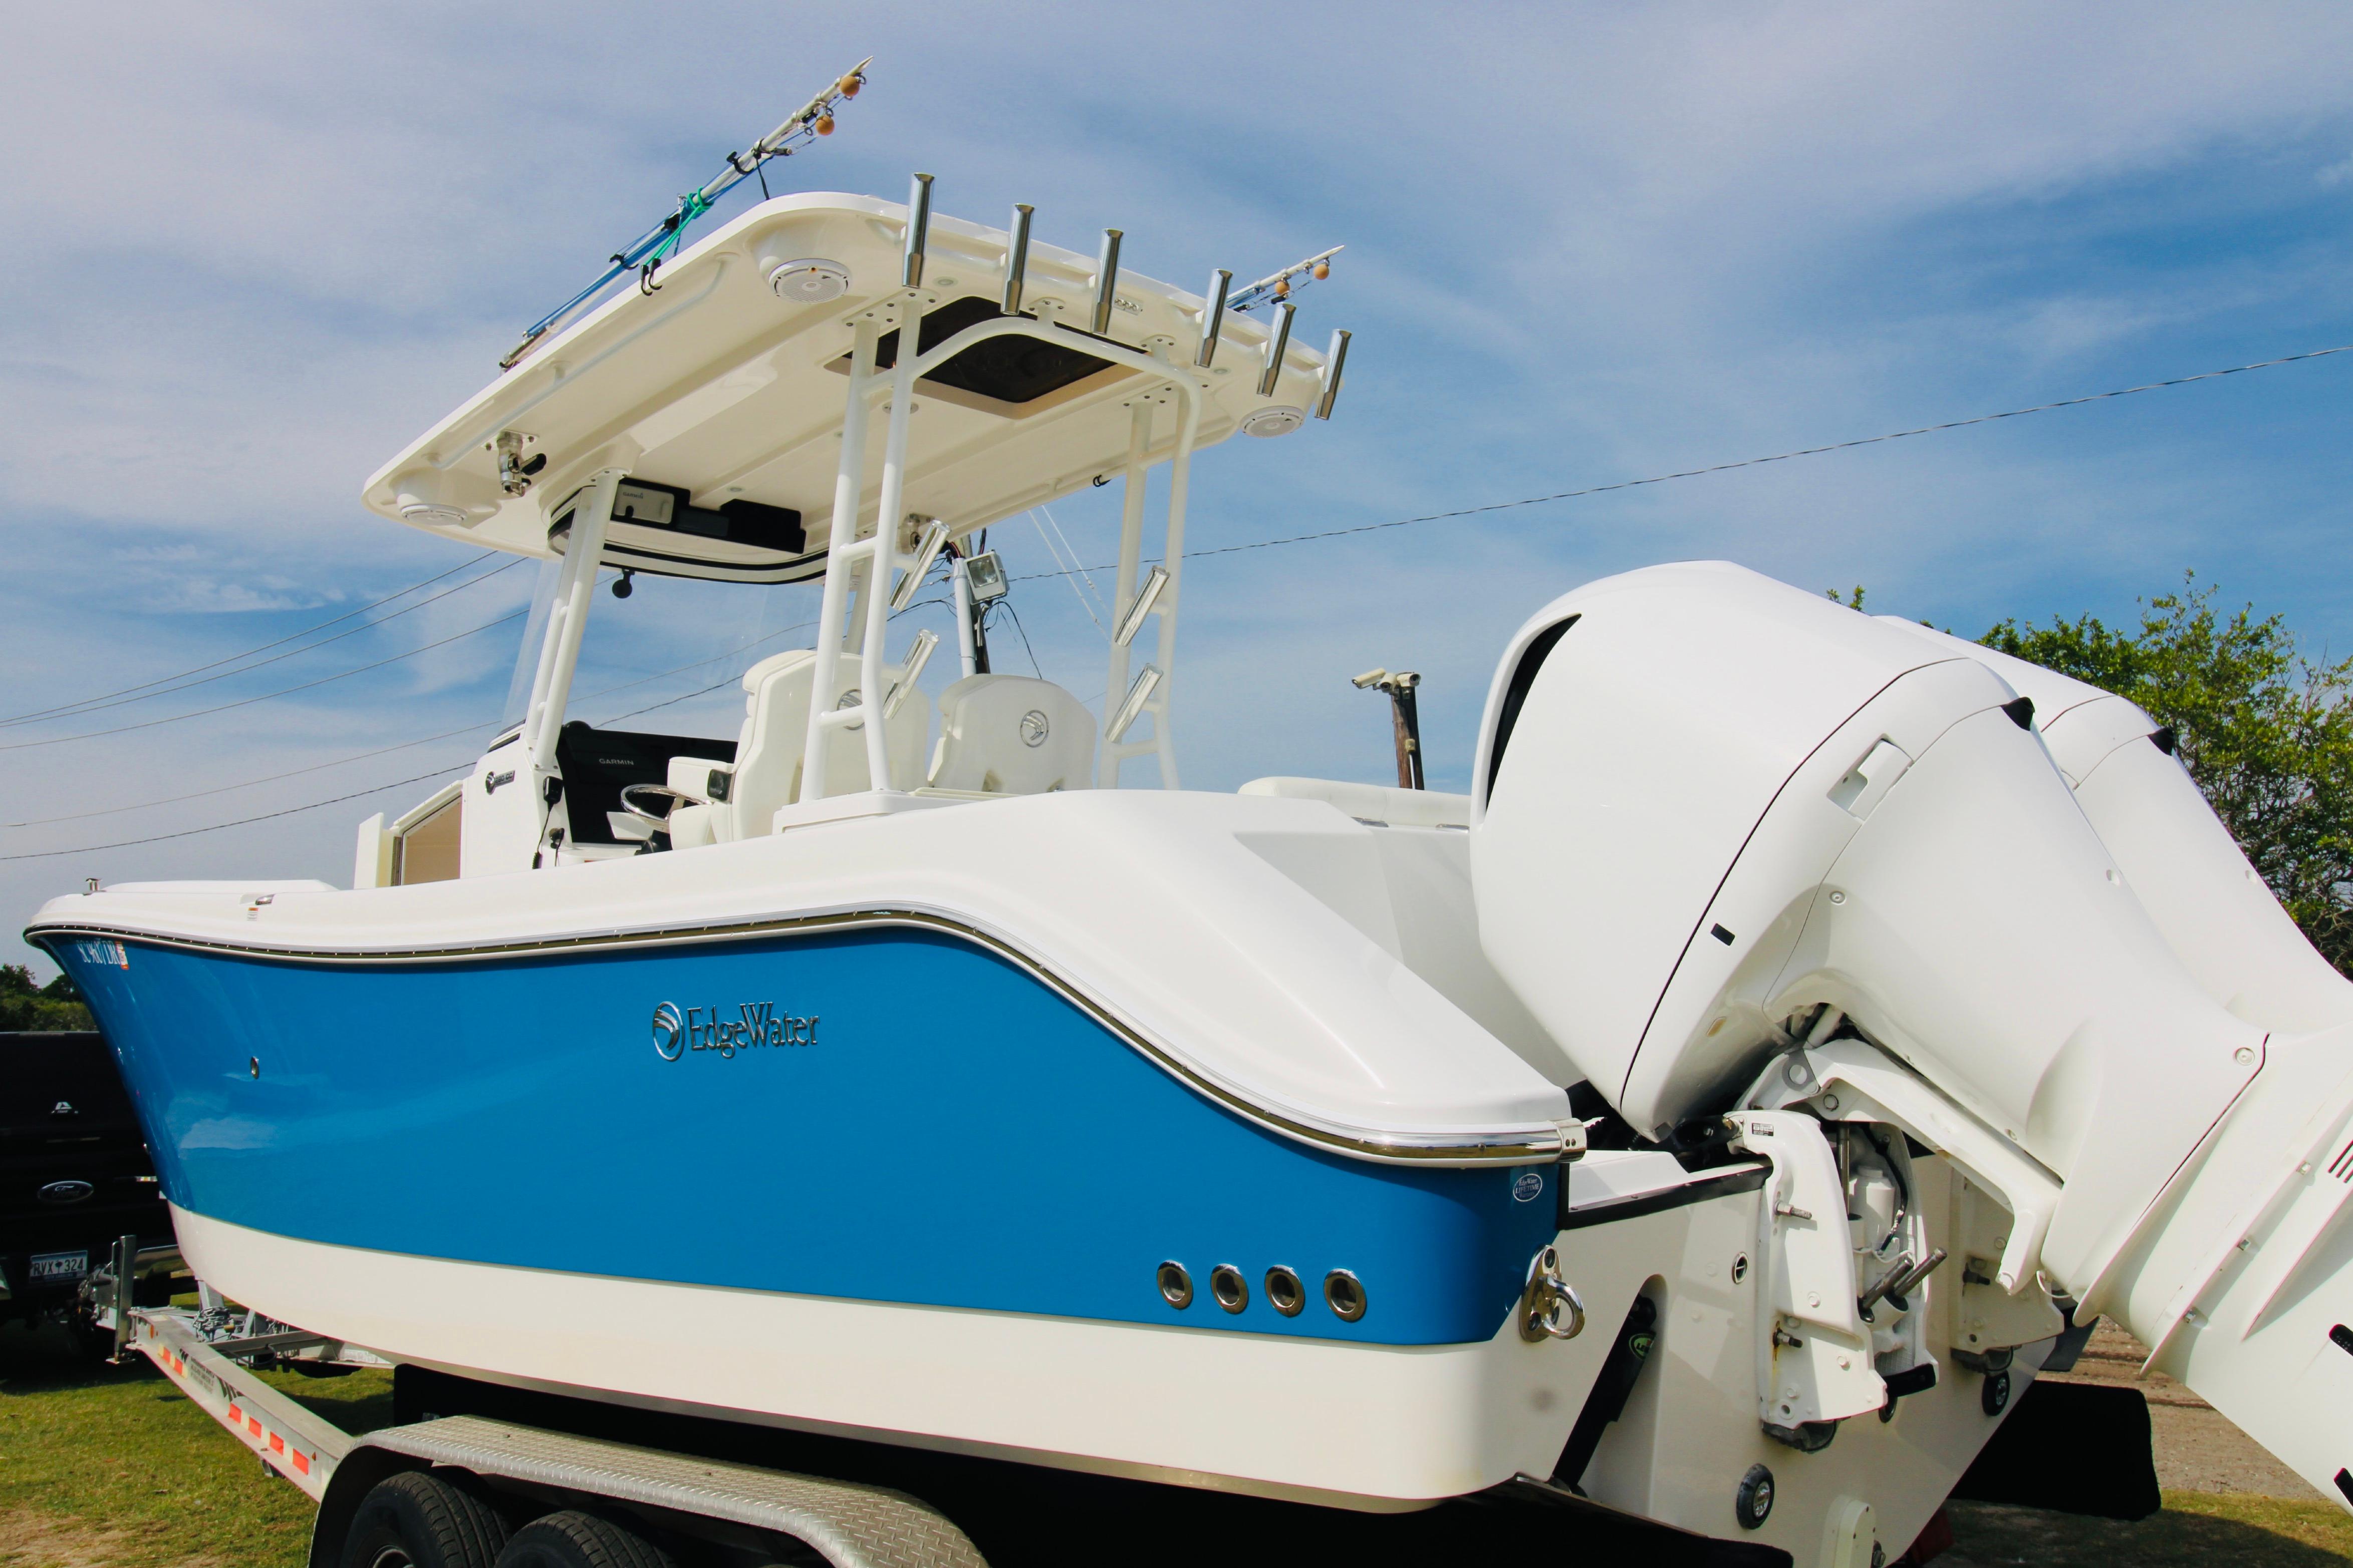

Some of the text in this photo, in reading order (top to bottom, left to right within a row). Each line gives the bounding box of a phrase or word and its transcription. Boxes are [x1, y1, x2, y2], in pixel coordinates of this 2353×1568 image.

[505, 772, 513, 780] CC
[686, 1001, 821, 1059] EdgeWater
[1515, 1183, 1540, 1194] LIFETIME
[33, 1258, 84, 1276] RVX 324
